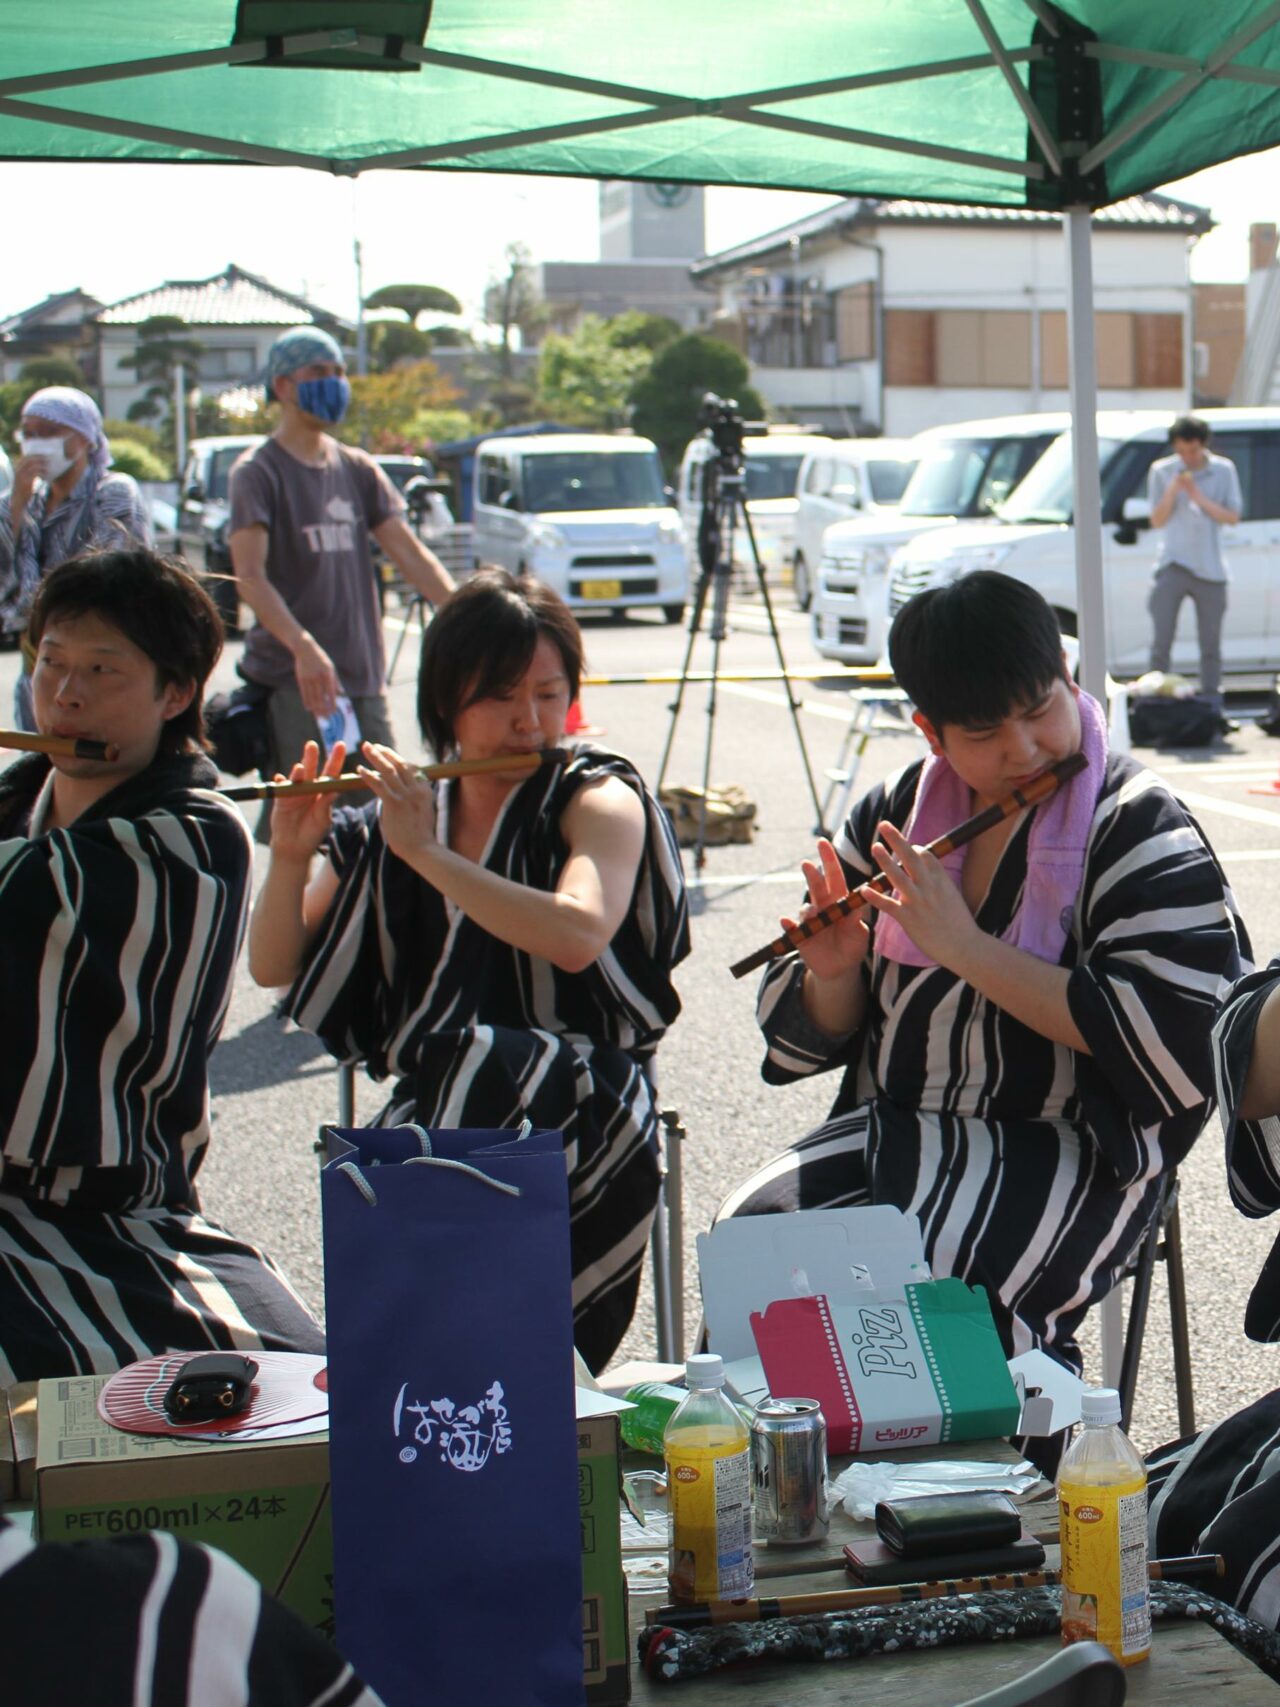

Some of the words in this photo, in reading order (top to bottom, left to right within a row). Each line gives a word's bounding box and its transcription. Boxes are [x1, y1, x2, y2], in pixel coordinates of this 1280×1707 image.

[851, 1308, 918, 1380] Piz
[393, 1380, 508, 1445] はせがわ
